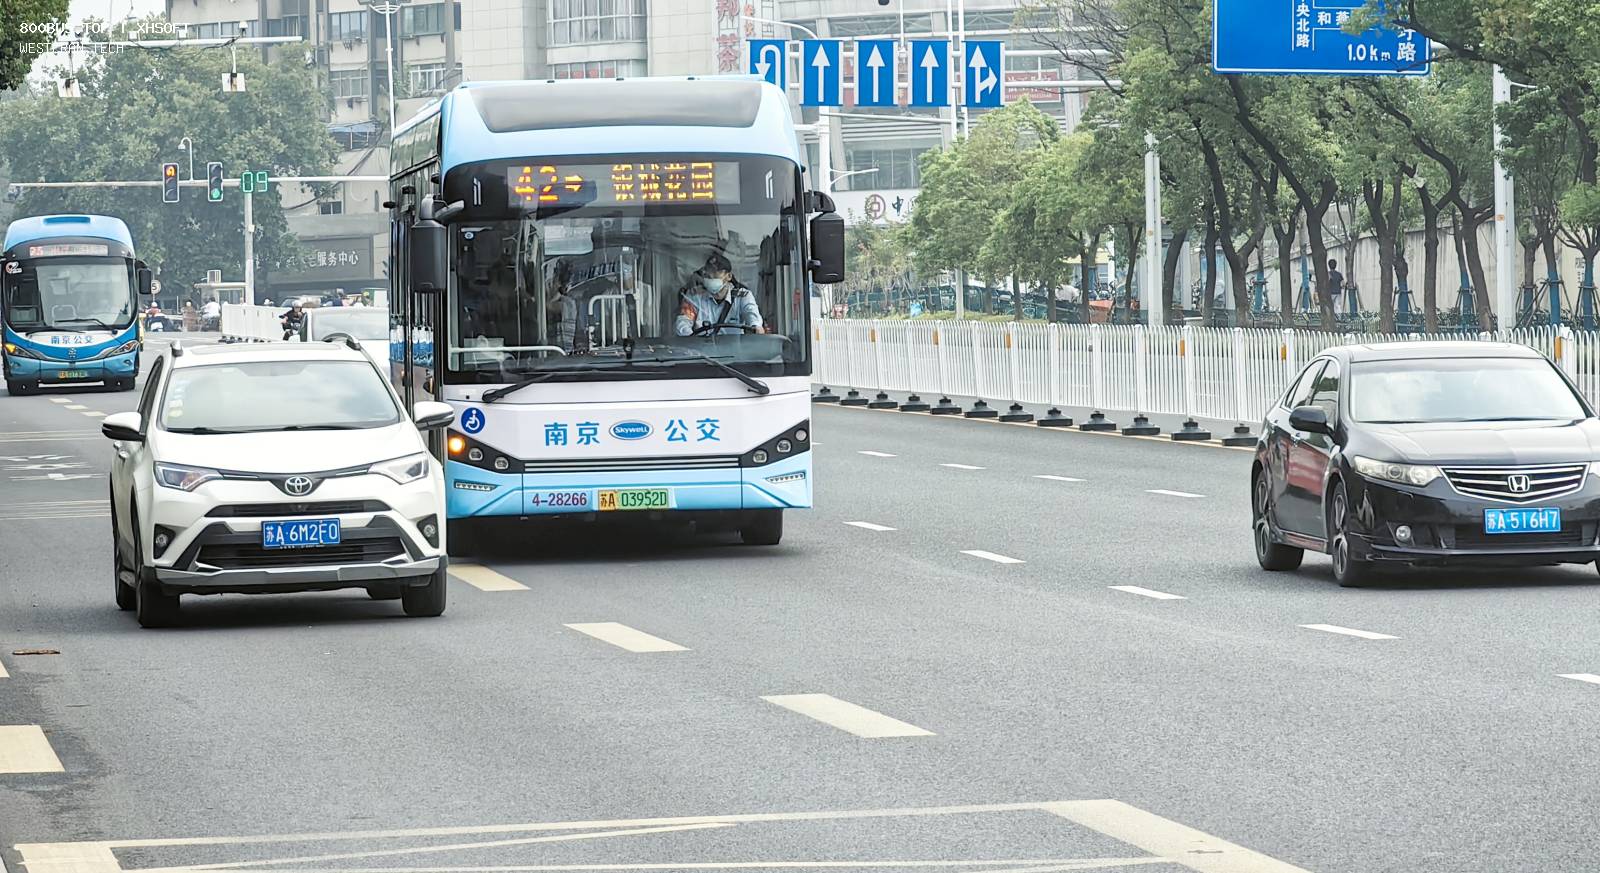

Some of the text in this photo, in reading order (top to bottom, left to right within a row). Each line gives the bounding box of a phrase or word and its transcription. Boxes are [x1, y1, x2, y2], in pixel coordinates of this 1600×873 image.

[1296, 0, 1311, 48] 央北路
[242, 171, 268, 192] 09
[515, 166, 559, 201] 42
[544, 421, 600, 447] 南京
[664, 418, 721, 442] 公交
[532, 492, 588, 508] 4-28266
